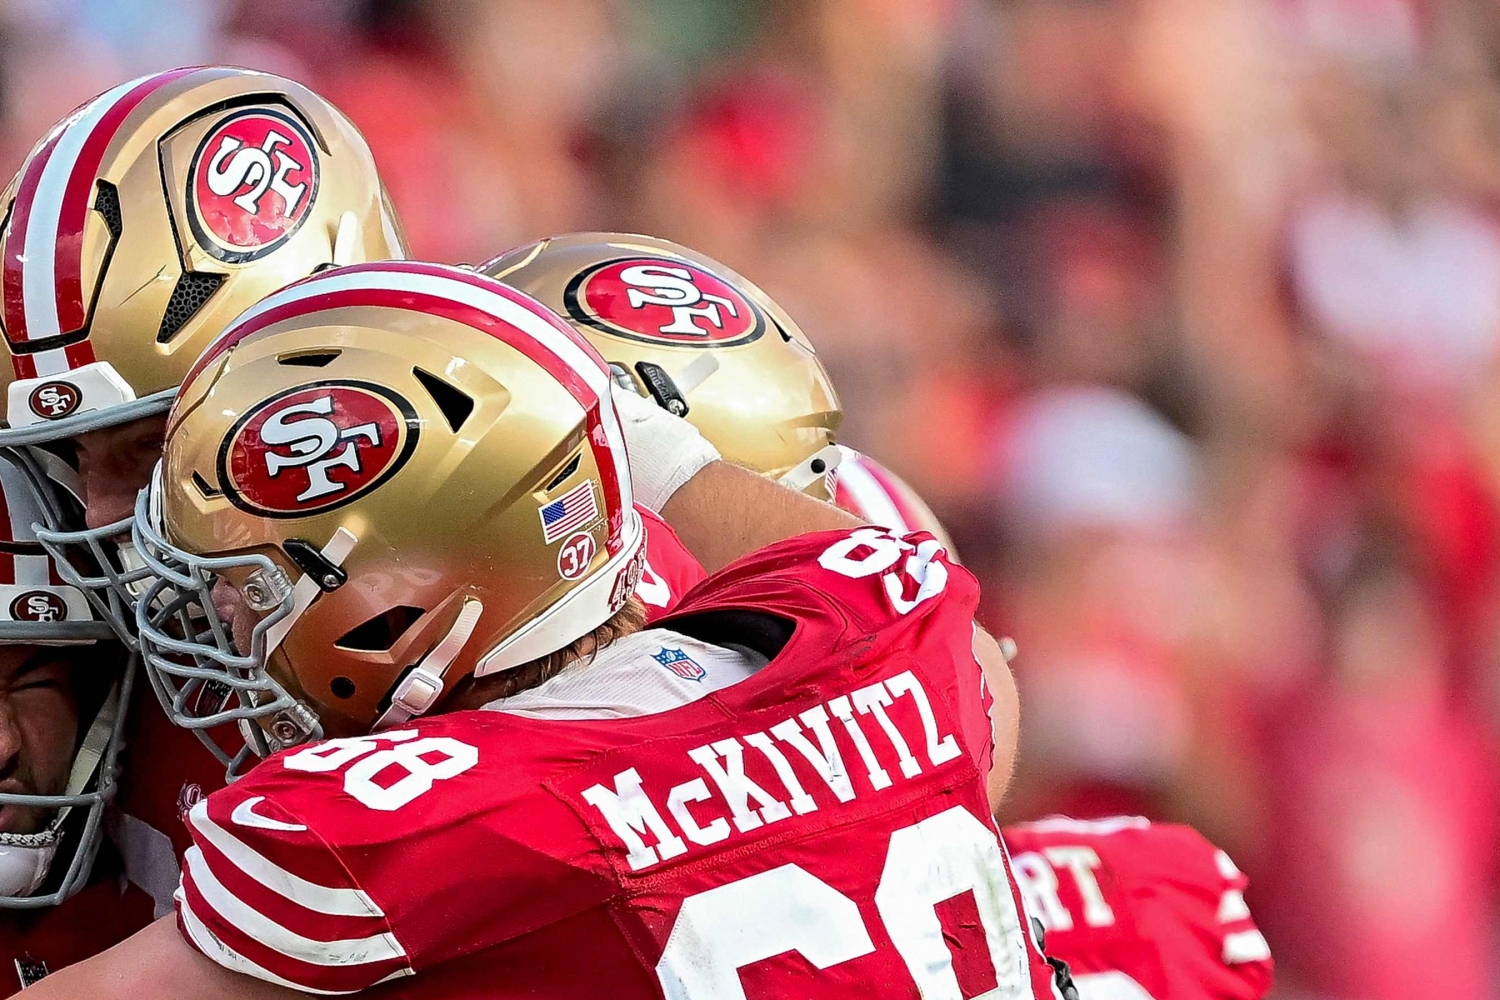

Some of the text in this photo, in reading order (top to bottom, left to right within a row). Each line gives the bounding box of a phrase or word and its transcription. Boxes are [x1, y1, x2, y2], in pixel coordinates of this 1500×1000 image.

[207, 129, 307, 217] SF
[619, 264, 739, 336] SF
[38, 386, 71, 416] SF
[259, 395, 381, 502] SF
[560, 536, 593, 577] 37
[282, 728, 480, 812] 68
[581, 669, 963, 872] McKIVITZ
